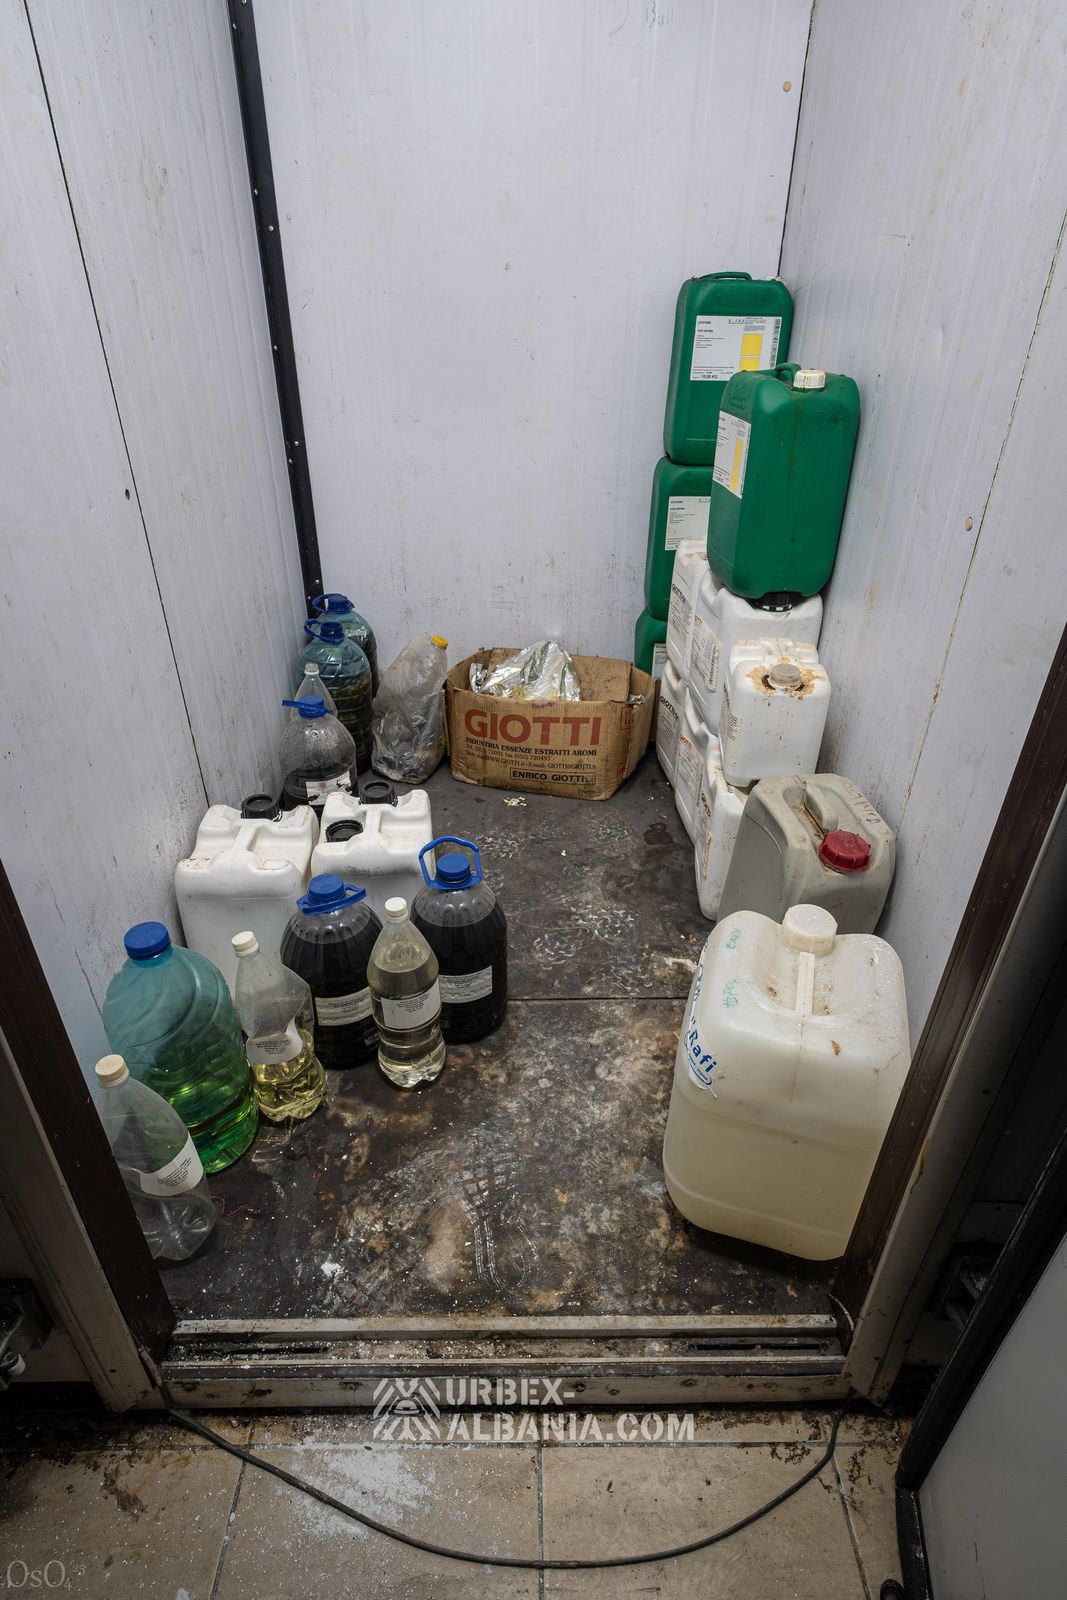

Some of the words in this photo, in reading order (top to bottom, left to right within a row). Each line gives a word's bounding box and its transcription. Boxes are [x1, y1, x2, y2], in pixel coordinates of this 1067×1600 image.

[464, 709, 601, 746] GIOTTI
[466, 737, 500, 750] INDUSTRIA
[501, 745, 532, 754] ESSENZE
[512, 770, 547, 780] ENRICO
[551, 774, 585, 782] GIOTTI
[689, 1029, 717, 1073] Rafi
